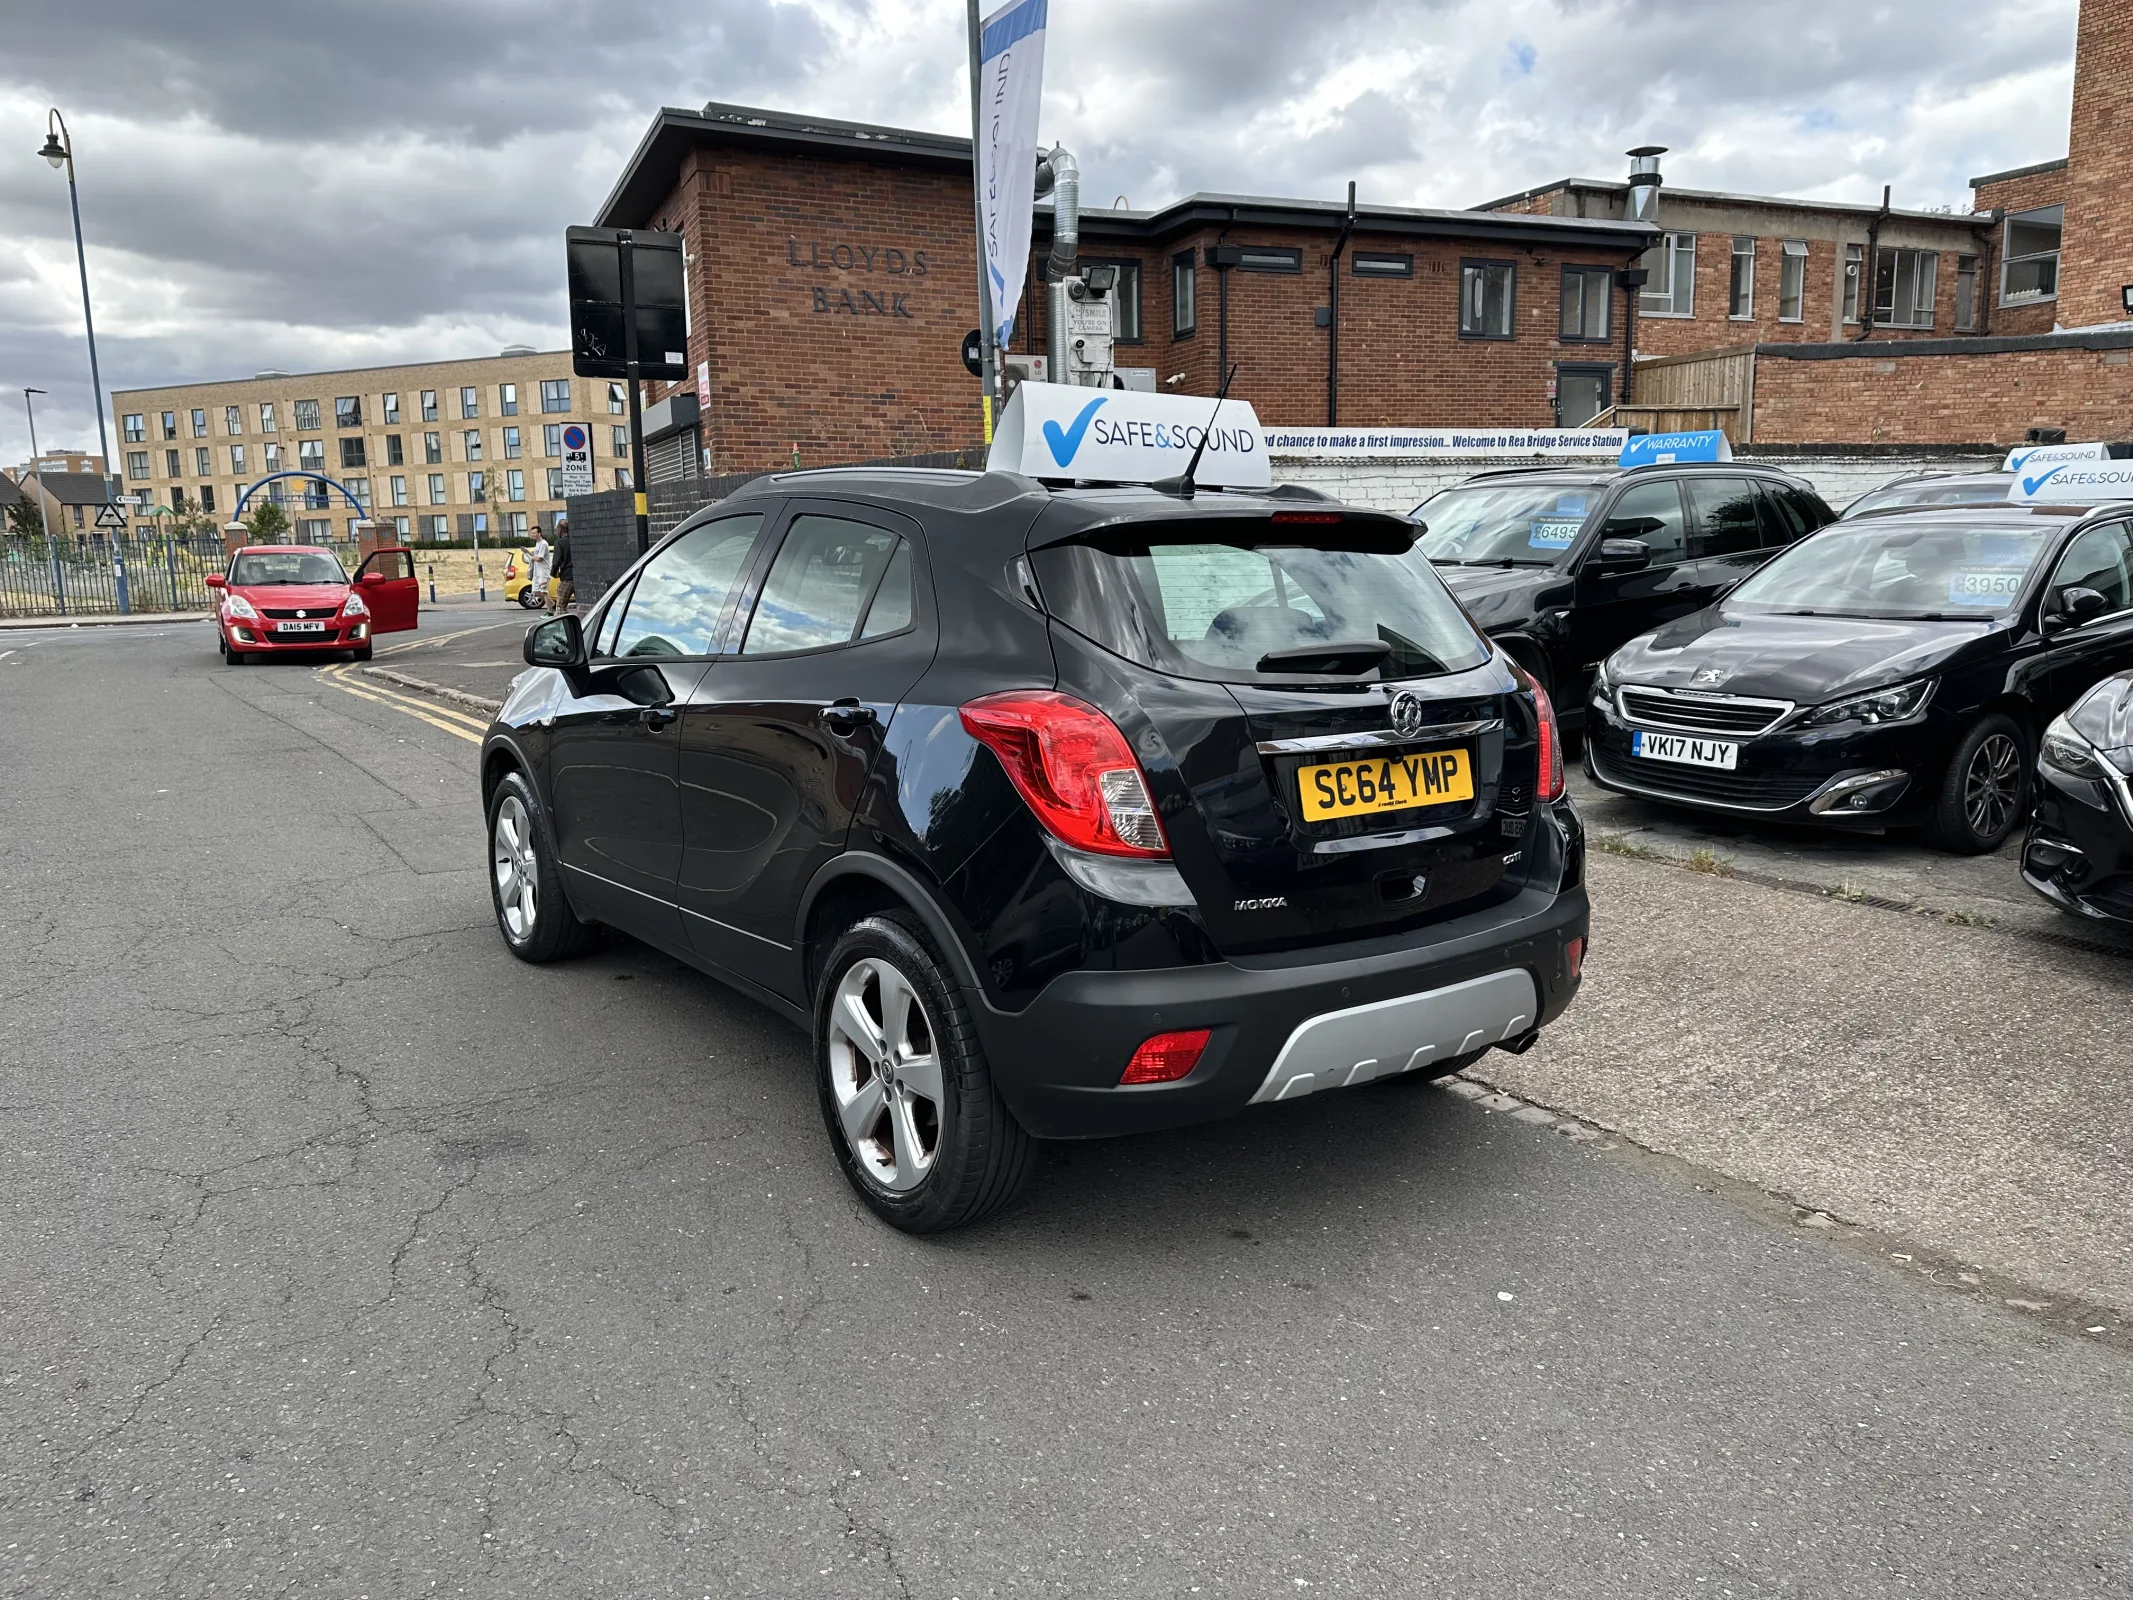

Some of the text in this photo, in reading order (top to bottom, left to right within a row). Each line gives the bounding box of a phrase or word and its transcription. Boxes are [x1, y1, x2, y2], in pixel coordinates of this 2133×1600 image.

[789, 239, 928, 276] LLOYDS
[812, 286, 915, 318] BANK
[1085, 308, 1107, 318] SMILE
[1094, 418, 1254, 453] SAFE&SOUND
[1276, 435, 1315, 447] chance
[1317, 435, 1328, 447] to
[1329, 435, 1357, 447] make
[1359, 437, 1365, 447] a
[1367, 435, 1388, 447] first
[1452, 435, 1496, 447] Welcome
[1497, 436, 1507, 447] to
[1508, 435, 1525, 447] Rea
[1526, 435, 1557, 449] Bridge
[1558, 435, 1590, 447] Service
[1592, 435, 1623, 447] Station
[1647, 435, 1714, 450] WARRANTY
[2029, 450, 2096, 463] SAFE&SOUND
[565, 464, 588, 472] ZONE
[2050, 471, 2133, 485] SAFE&SOU
[283, 623, 302, 631] DA15
[1648, 735, 1730, 763] VK17 NJY
[1314, 754, 1459, 810] SC64 YMP
[1233, 896, 1288, 911] MOKKA
